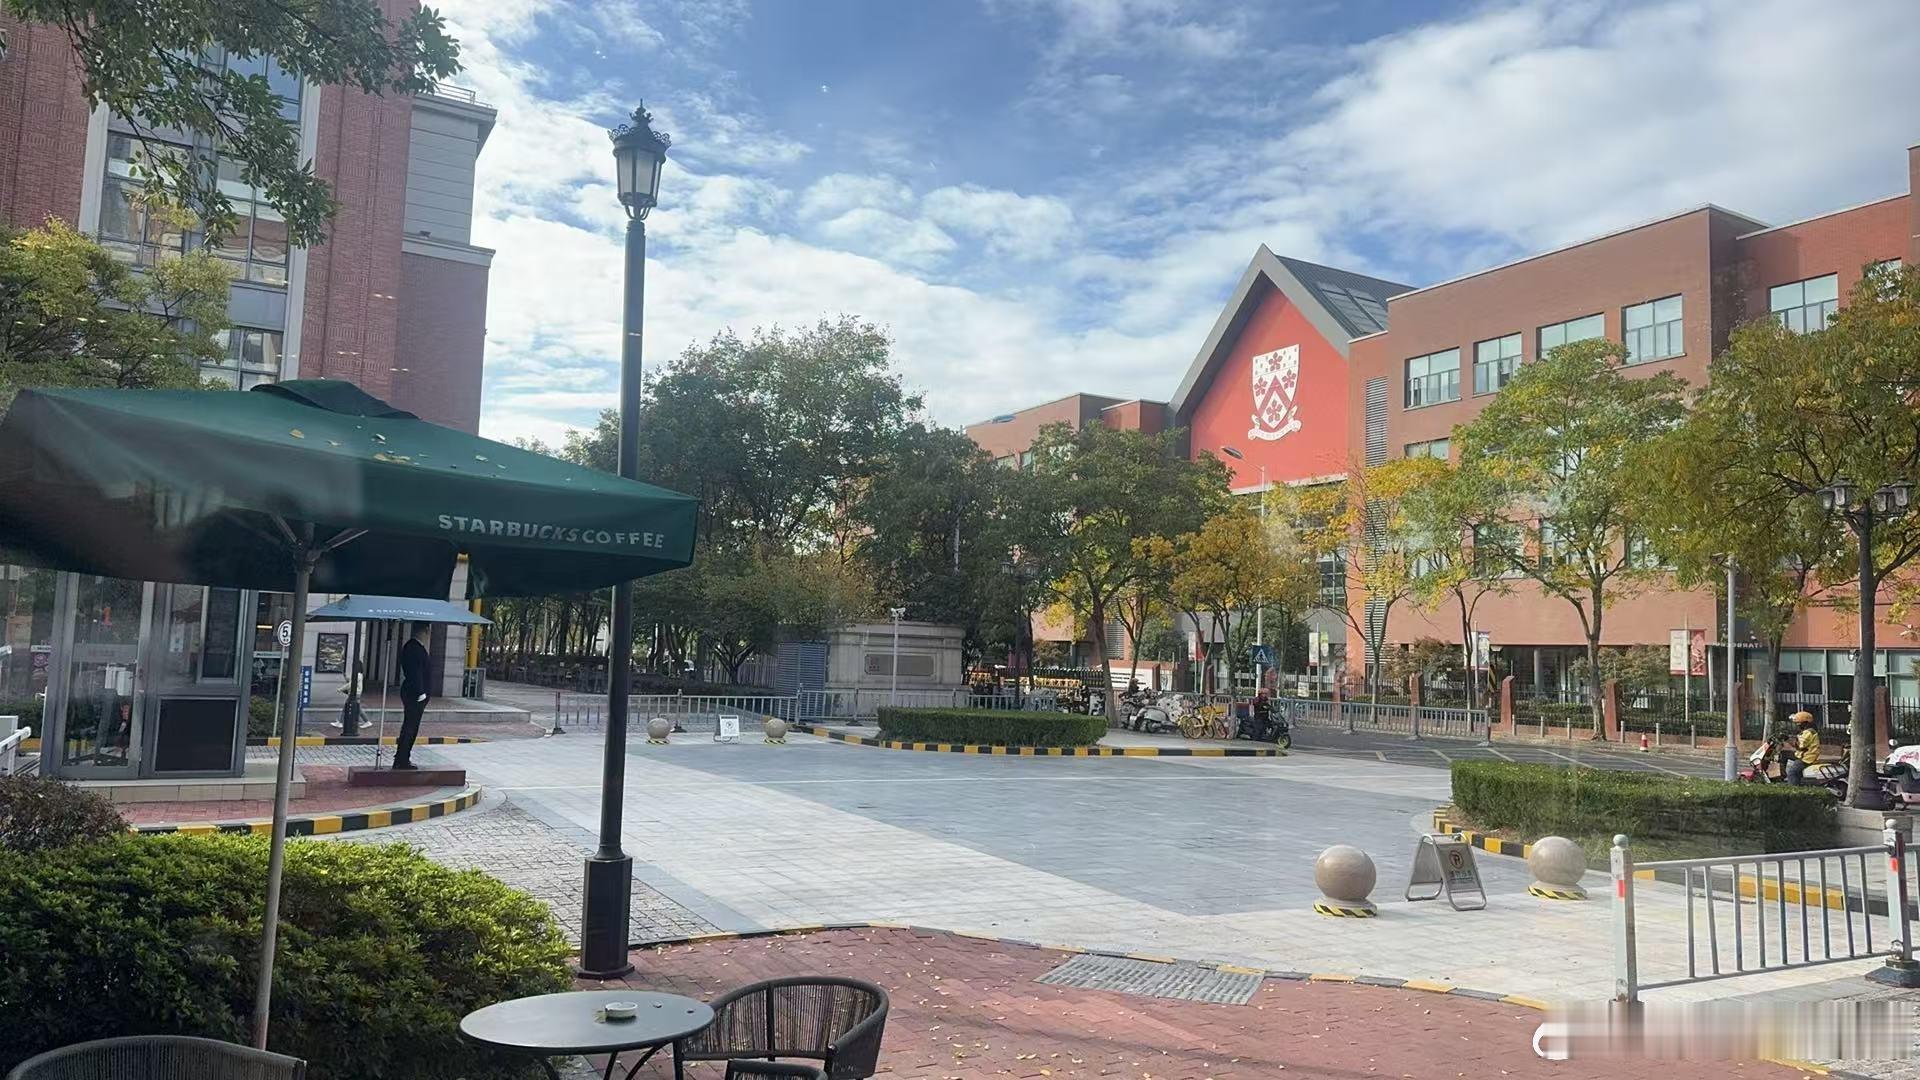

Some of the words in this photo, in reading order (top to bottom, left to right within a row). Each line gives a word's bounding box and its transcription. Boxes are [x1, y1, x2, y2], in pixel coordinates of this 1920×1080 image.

[438, 514, 577, 543] STARBUCKS
[581, 529, 665, 548] COFFEE
[282, 626, 288, 637] 5
